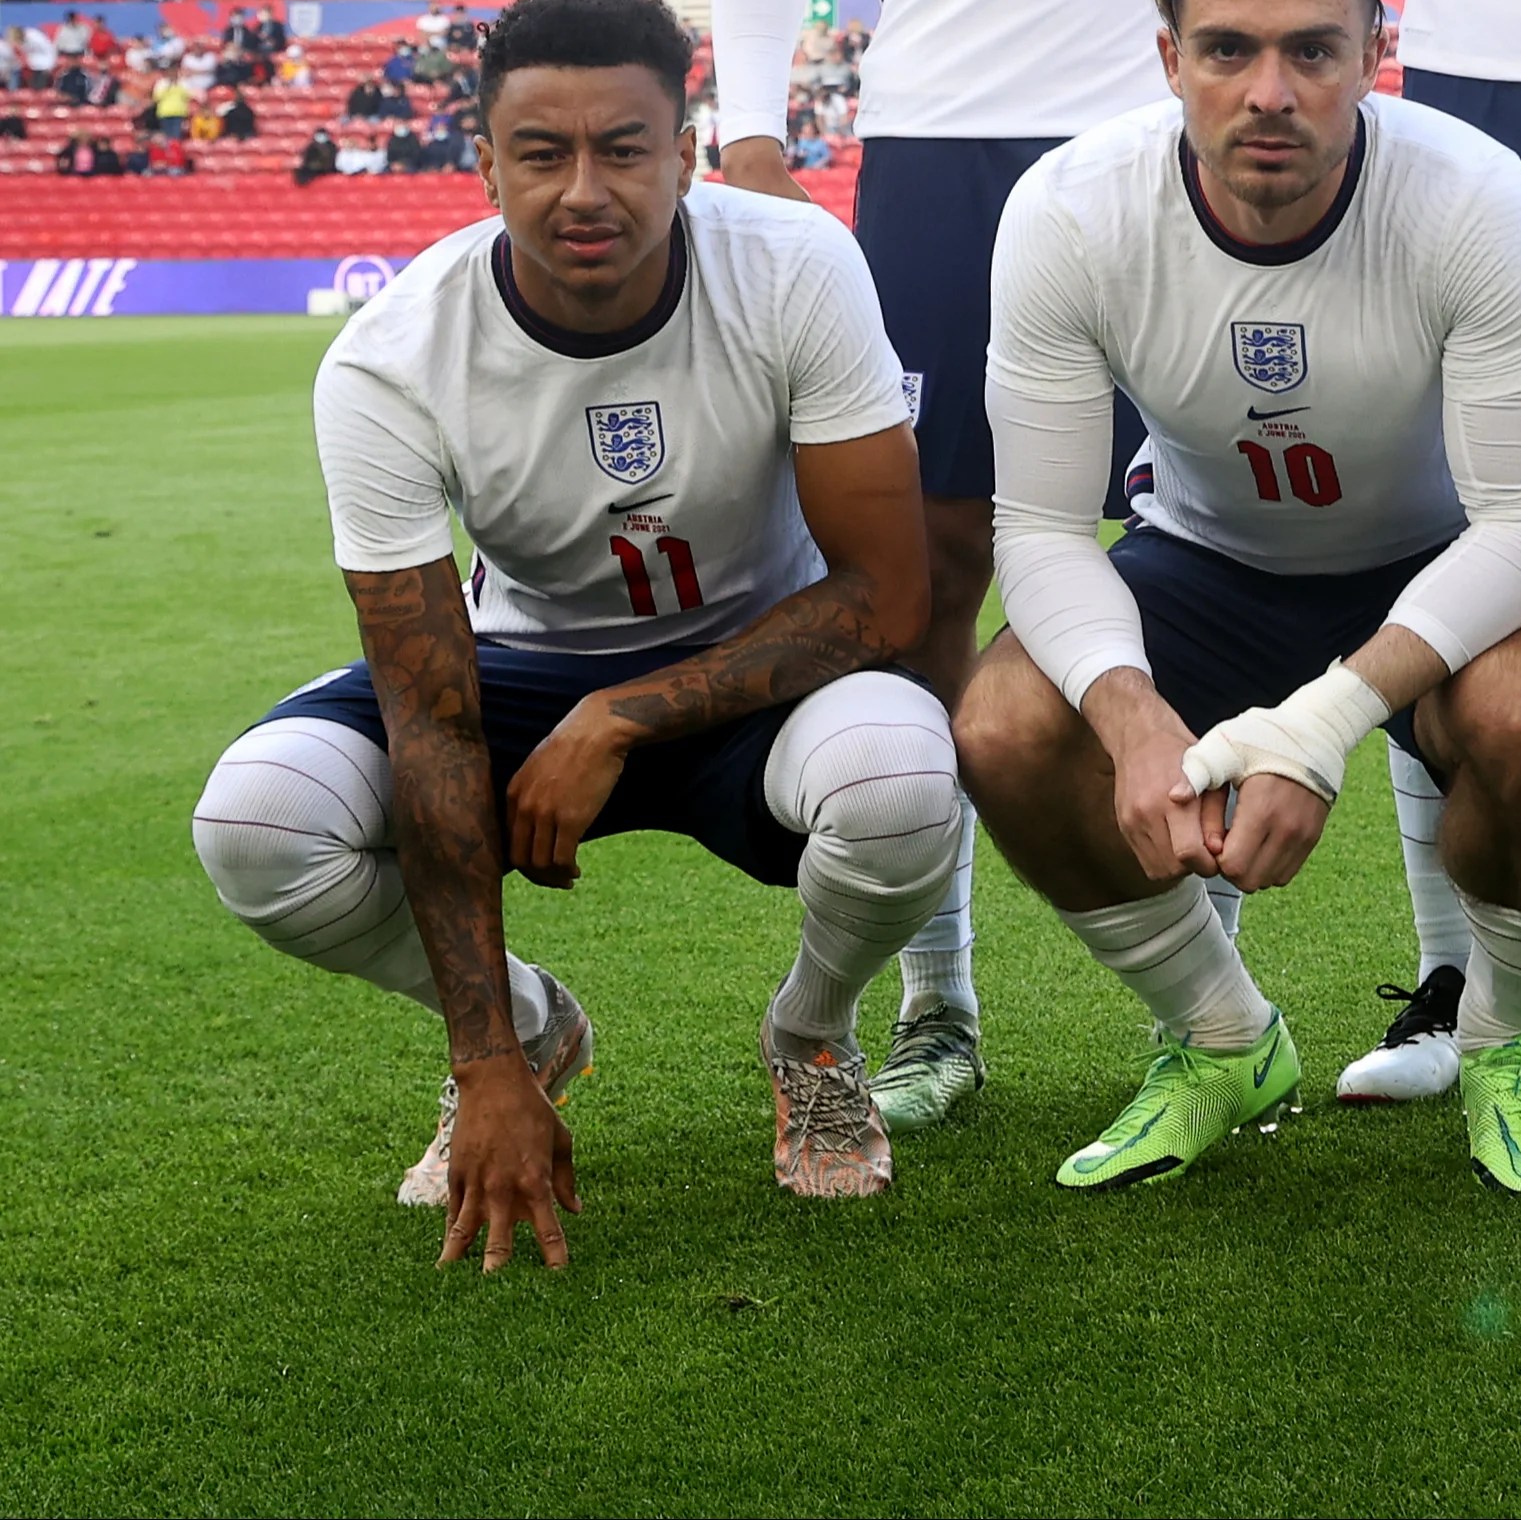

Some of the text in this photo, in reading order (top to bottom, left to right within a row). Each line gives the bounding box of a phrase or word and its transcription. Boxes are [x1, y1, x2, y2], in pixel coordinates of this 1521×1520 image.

[1262, 422, 1300, 431] AUSTRIA
[1265, 430, 1286, 438] JUNE
[1236, 440, 1342, 508] 10
[627, 513, 664, 524] AUSTRIA
[609, 535, 704, 616] 11
